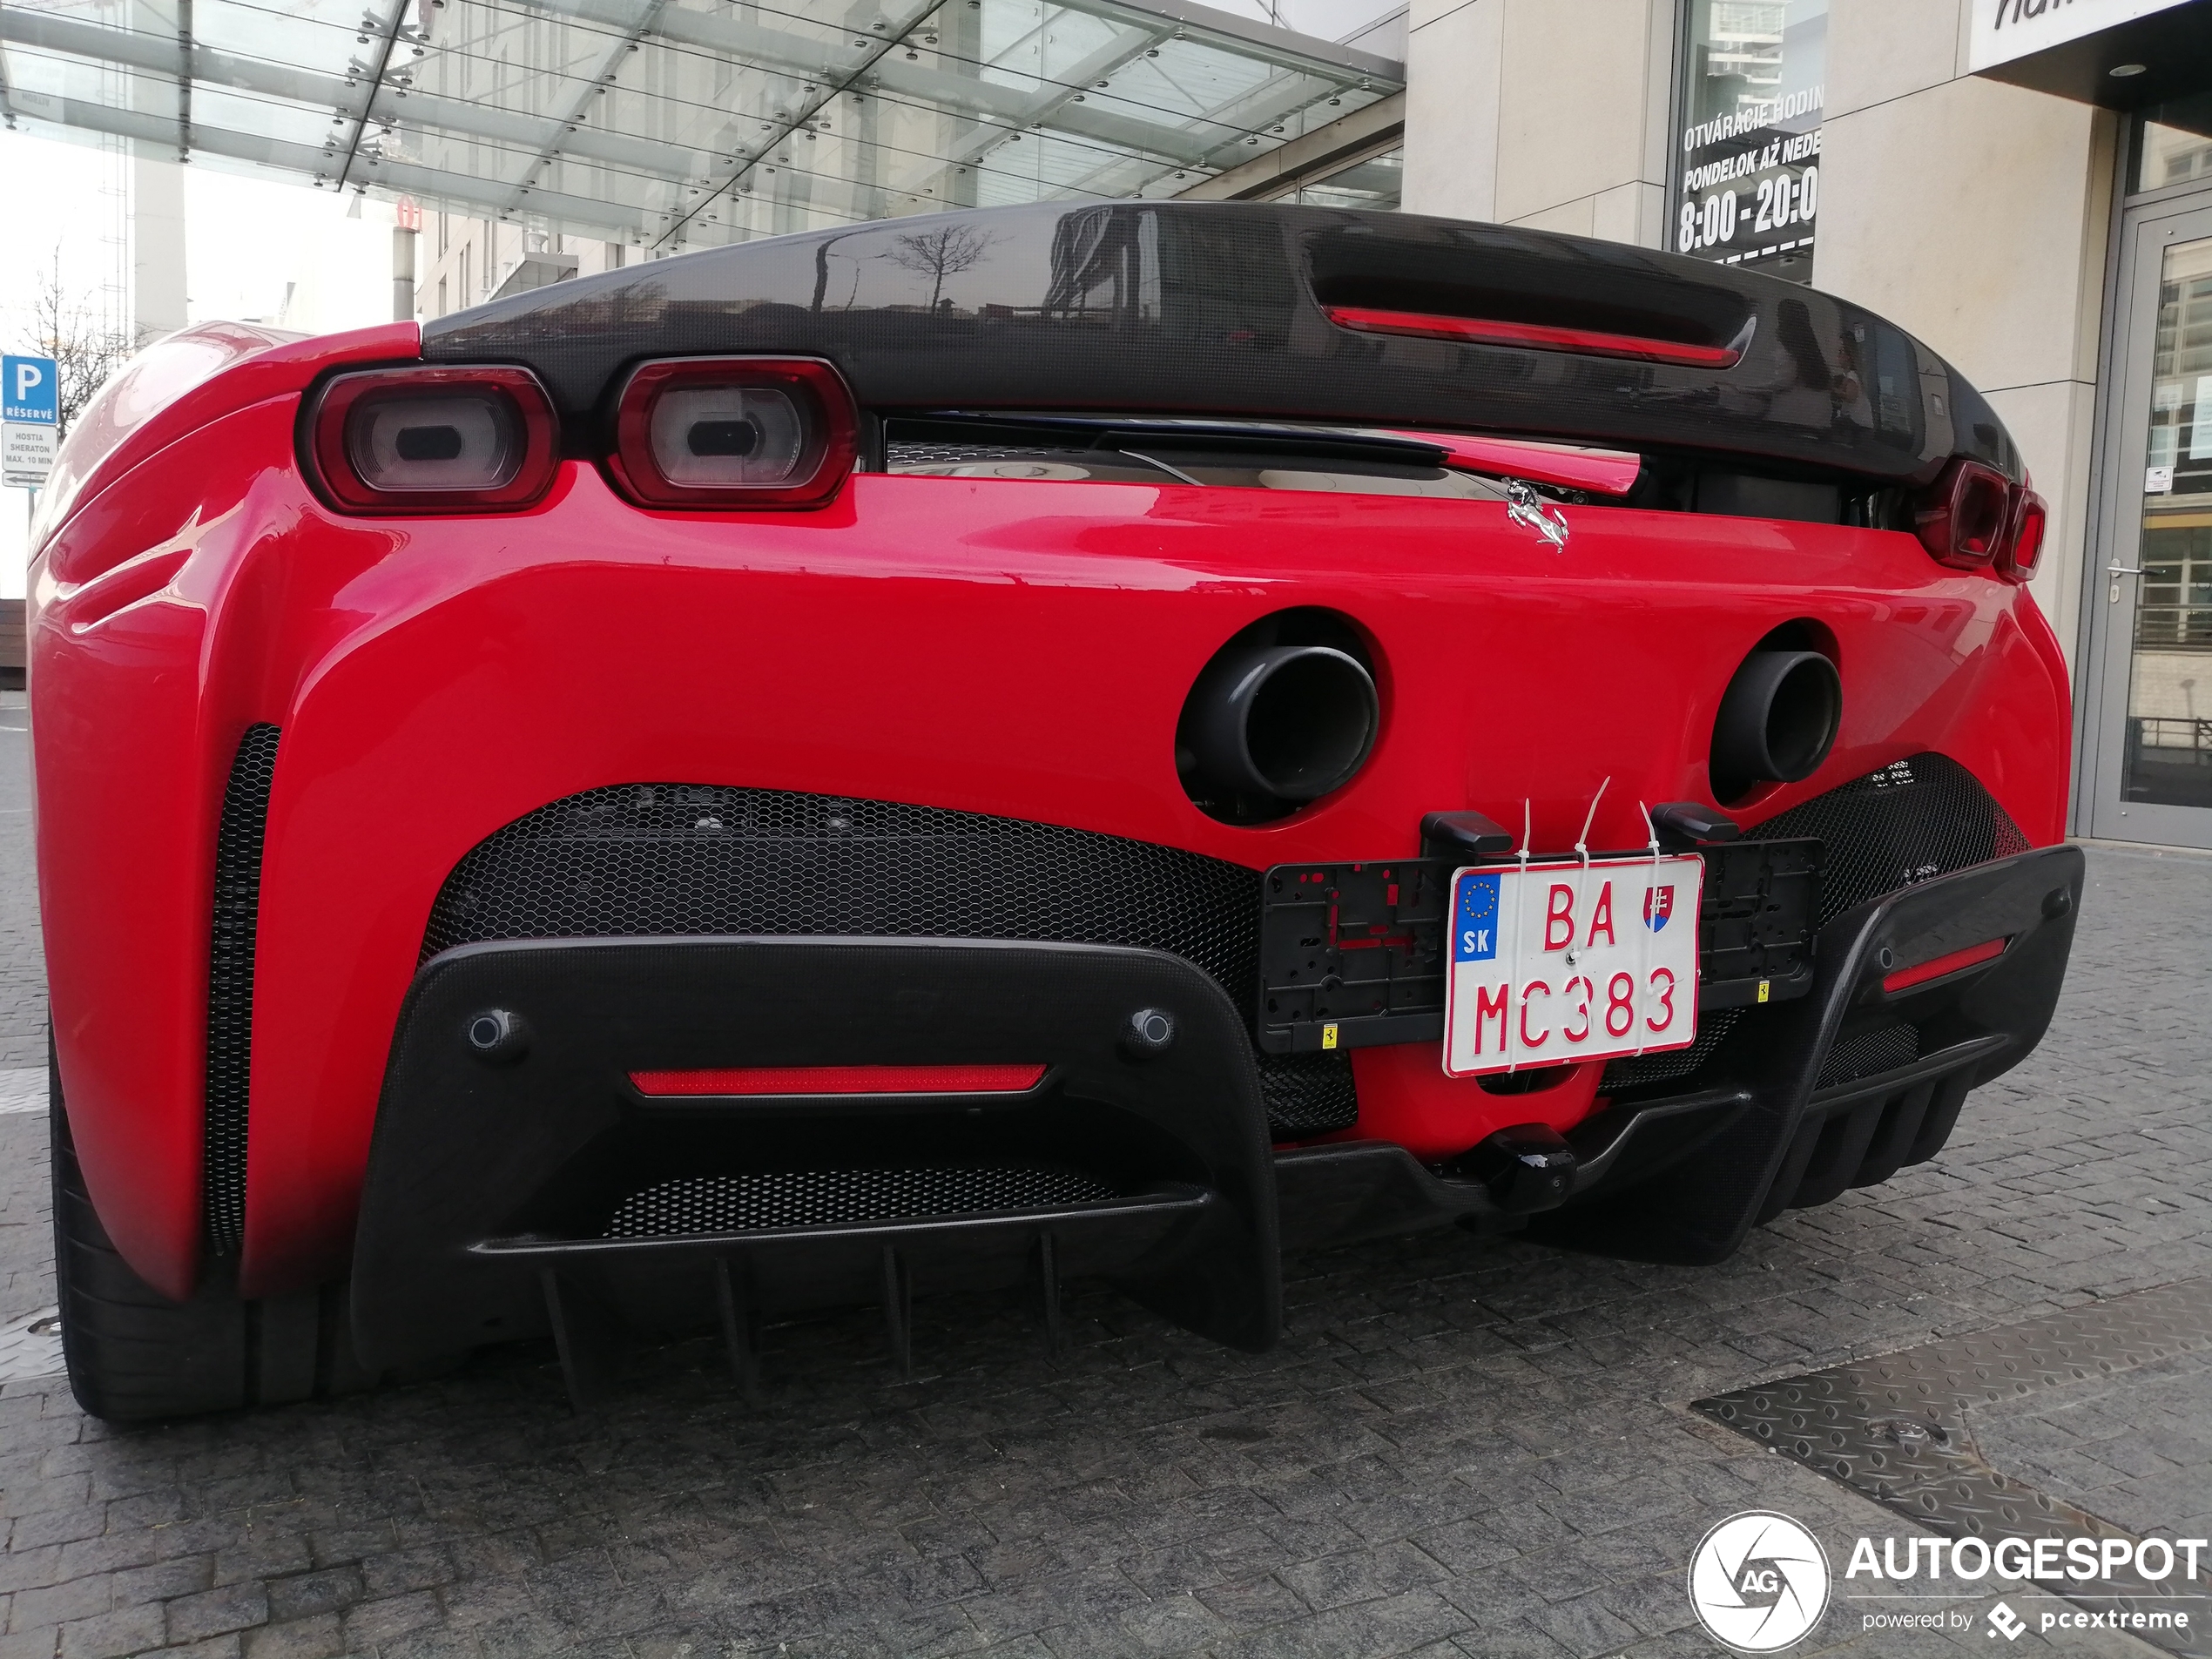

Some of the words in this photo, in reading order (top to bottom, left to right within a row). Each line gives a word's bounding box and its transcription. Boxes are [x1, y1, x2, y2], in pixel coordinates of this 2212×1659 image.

[1684, 103, 1769, 152] OTVÁRACIE
[1683, 149, 1759, 193] PONDELOK
[1759, 137, 1781, 171] AŽ
[1782, 130, 1822, 165] NEDE
[1679, 190, 1737, 253] 8:00
[1740, 207, 1751, 221] -
[1754, 165, 1818, 233] 20:0
[17, 364, 42, 401] P
[6, 406, 52, 420] RÉSERVÉ
[6, 455, 24, 463] MAX.
[28, 455, 36, 464] 10
[10, 443, 50, 453] SHERATON
[1543, 880, 1615, 952] BA
[1463, 929, 1490, 954] SK
[1474, 967, 1675, 1056] MC383
